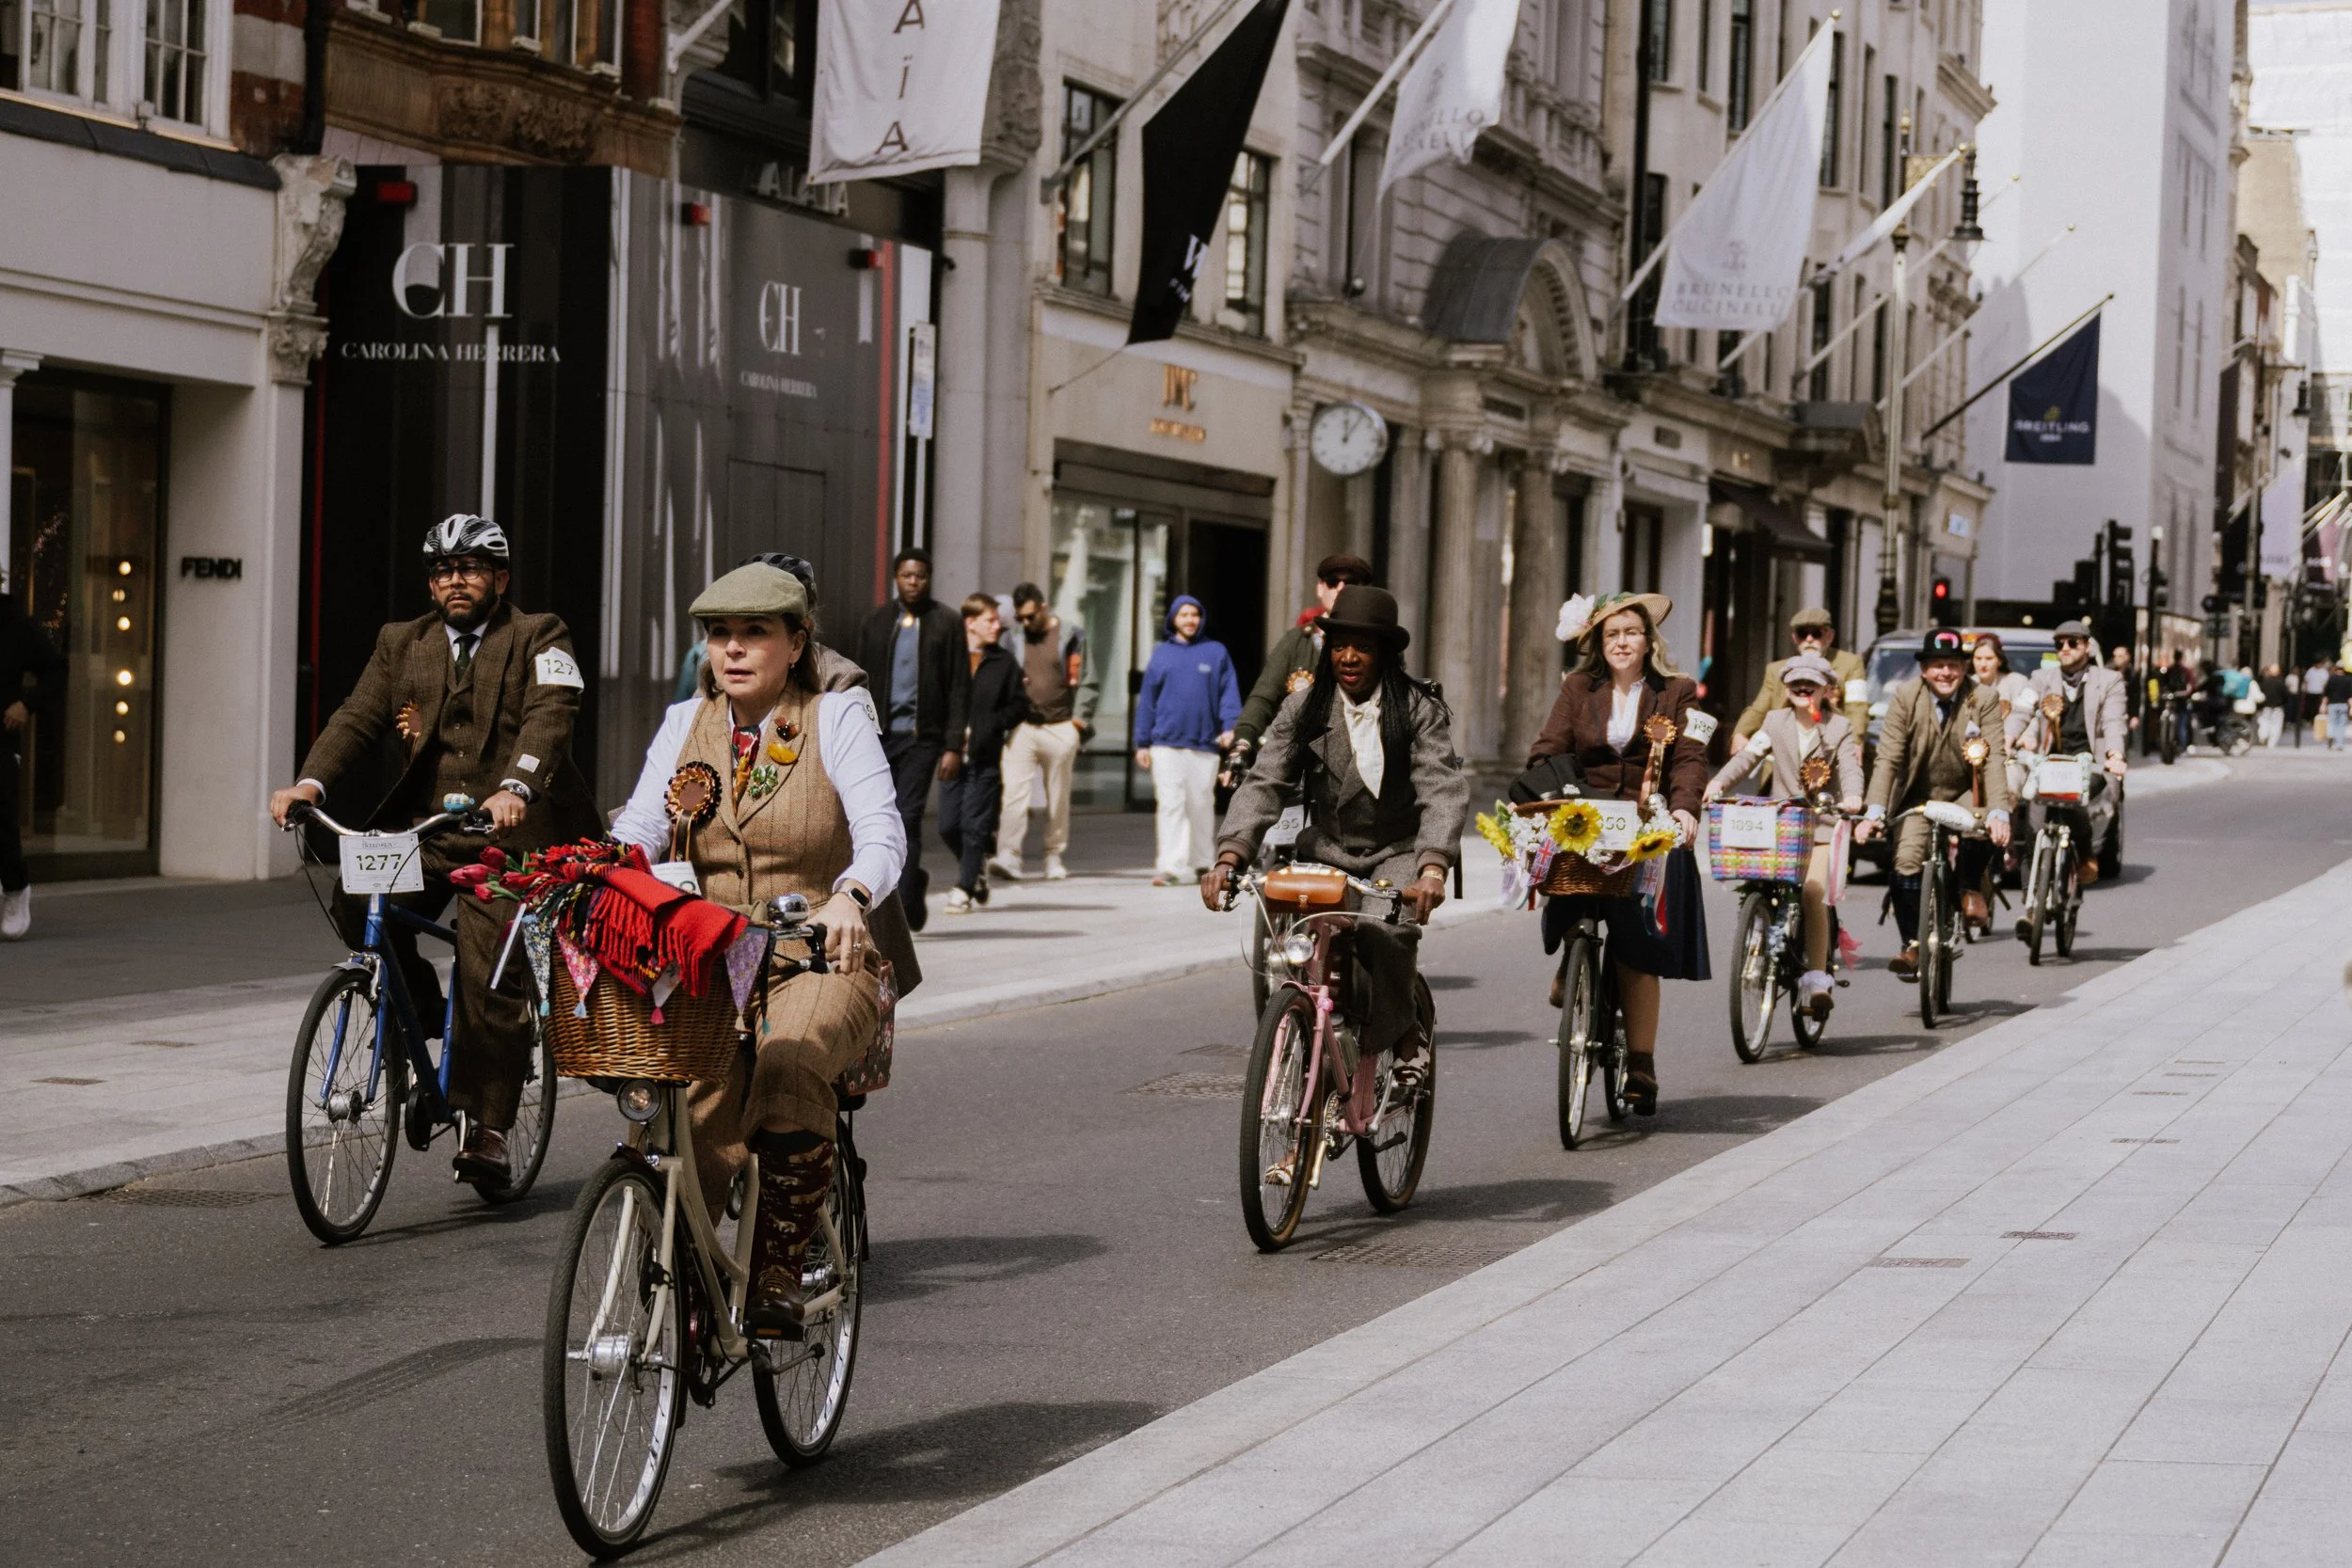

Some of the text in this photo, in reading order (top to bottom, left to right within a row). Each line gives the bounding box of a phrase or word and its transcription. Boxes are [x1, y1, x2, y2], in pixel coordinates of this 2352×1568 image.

[391, 242, 516, 320] CH
[758, 280, 802, 356] CH
[341, 341, 450, 360] CAROLINA
[2013, 420, 2090, 434] BREITLING
[181, 556, 243, 580] FENDI
[544, 658, 579, 675] 127
[1600, 816, 1627, 831] 50
[356, 853, 402, 871] 1277
